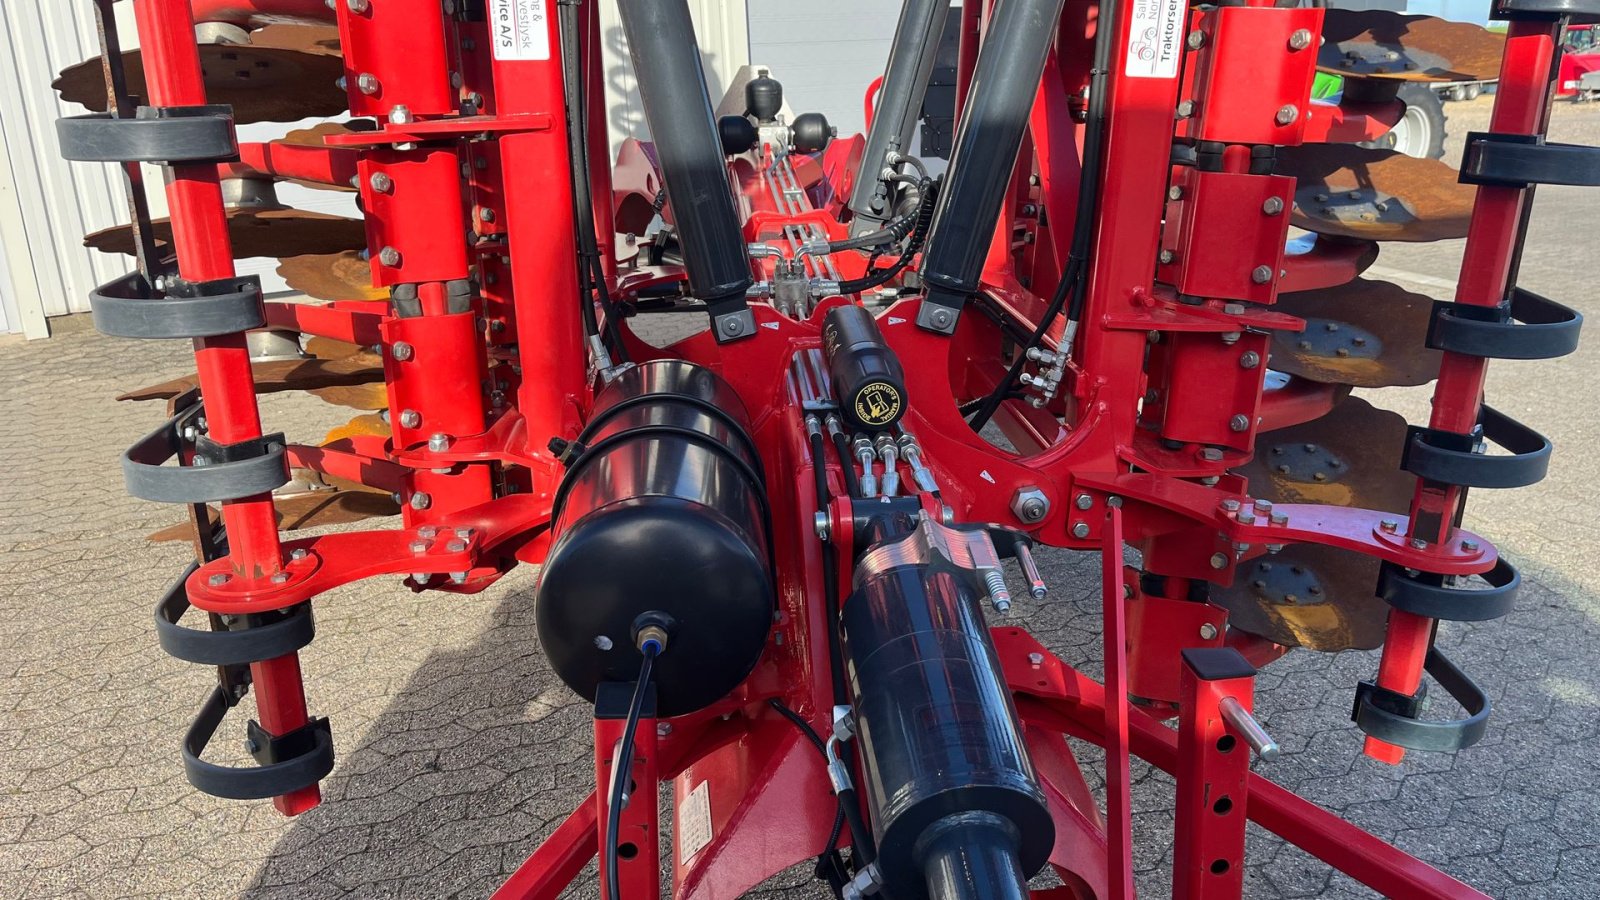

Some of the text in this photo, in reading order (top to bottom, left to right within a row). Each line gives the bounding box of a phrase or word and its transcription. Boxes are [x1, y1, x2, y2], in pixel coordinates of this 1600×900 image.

[500, 25, 512, 47] A/S
[858, 385, 898, 421] OPERATOR'S MANUAL INSIDE
